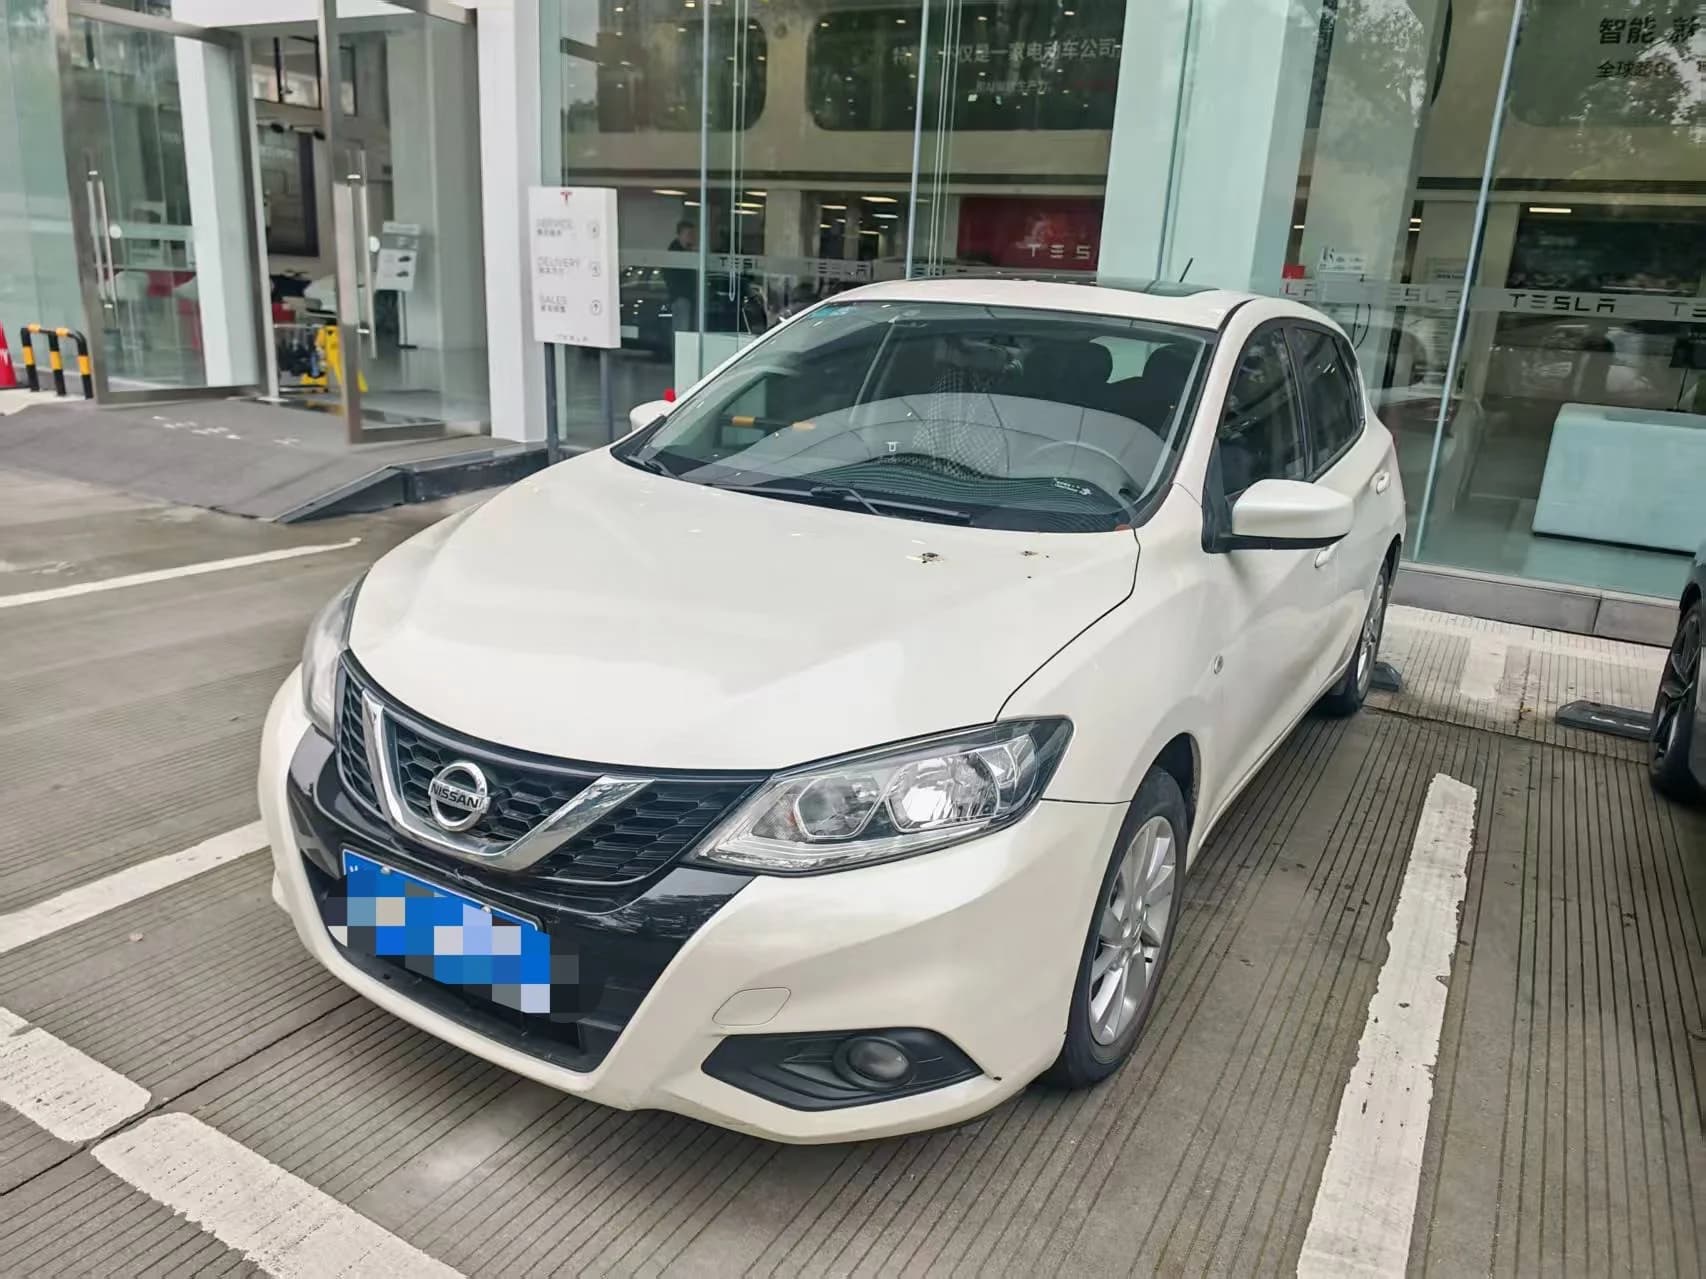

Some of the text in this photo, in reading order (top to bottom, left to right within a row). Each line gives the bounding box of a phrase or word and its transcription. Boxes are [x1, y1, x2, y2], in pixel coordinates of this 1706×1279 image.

[1599, 17, 1657, 45] 智能
[1508, 293, 1617, 313] TESLA
[430, 783, 479, 809] NISSAN
